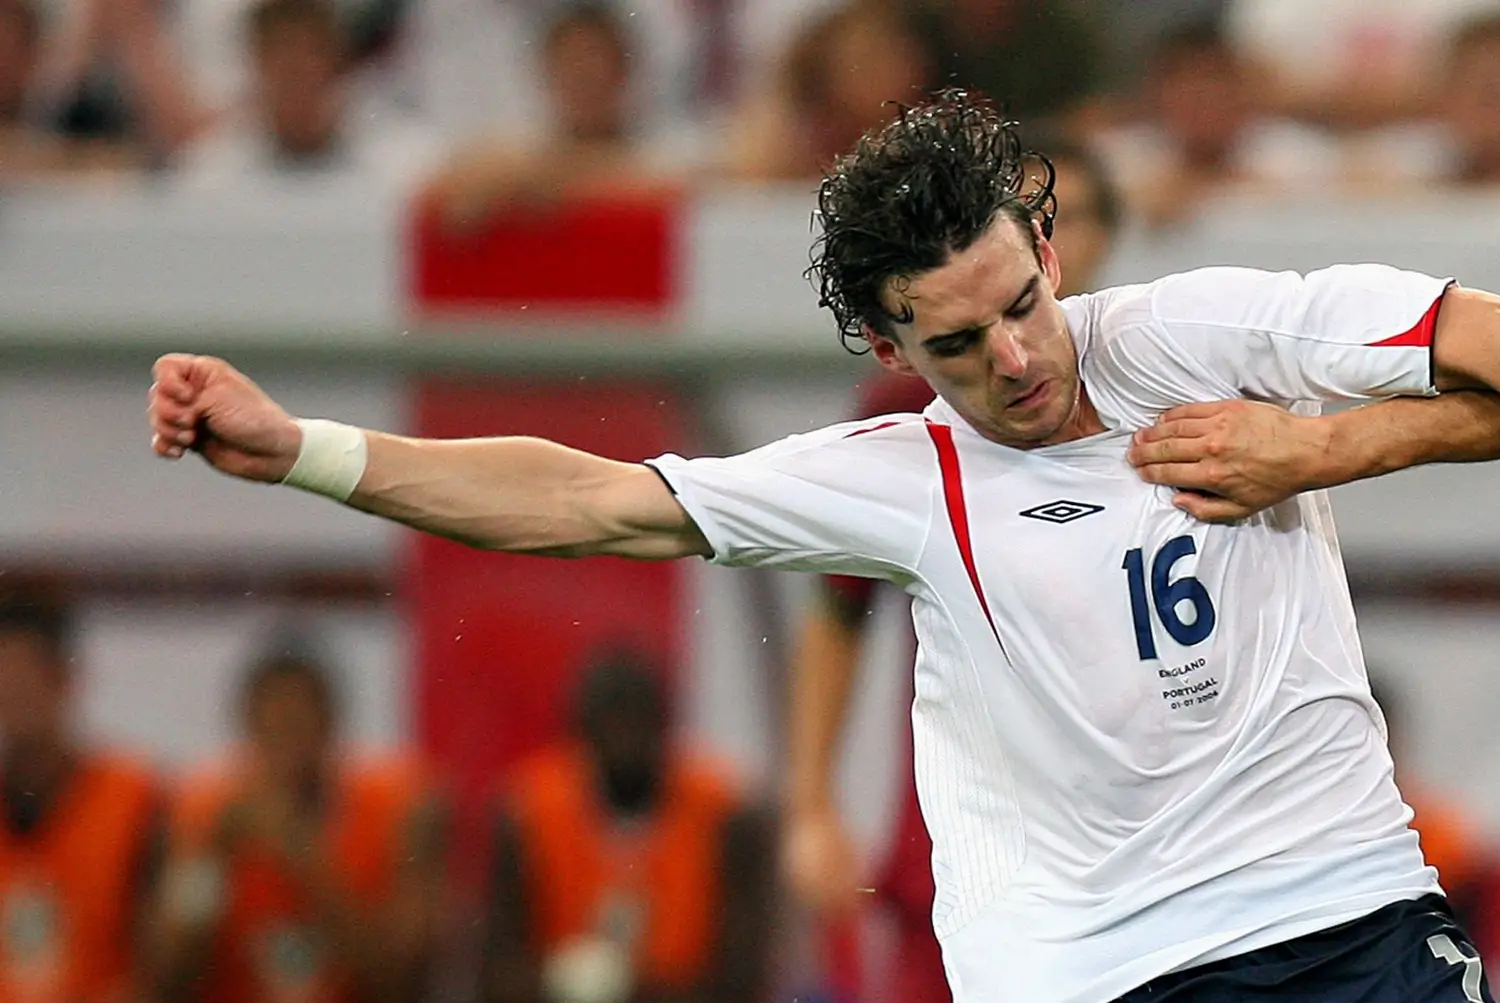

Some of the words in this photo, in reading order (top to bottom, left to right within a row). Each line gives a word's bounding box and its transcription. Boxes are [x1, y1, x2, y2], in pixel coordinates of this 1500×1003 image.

[1121, 534, 1216, 660] 16
[1158, 658, 1206, 678] ENGLAND
[1162, 677, 1218, 699] PORTUGAL
